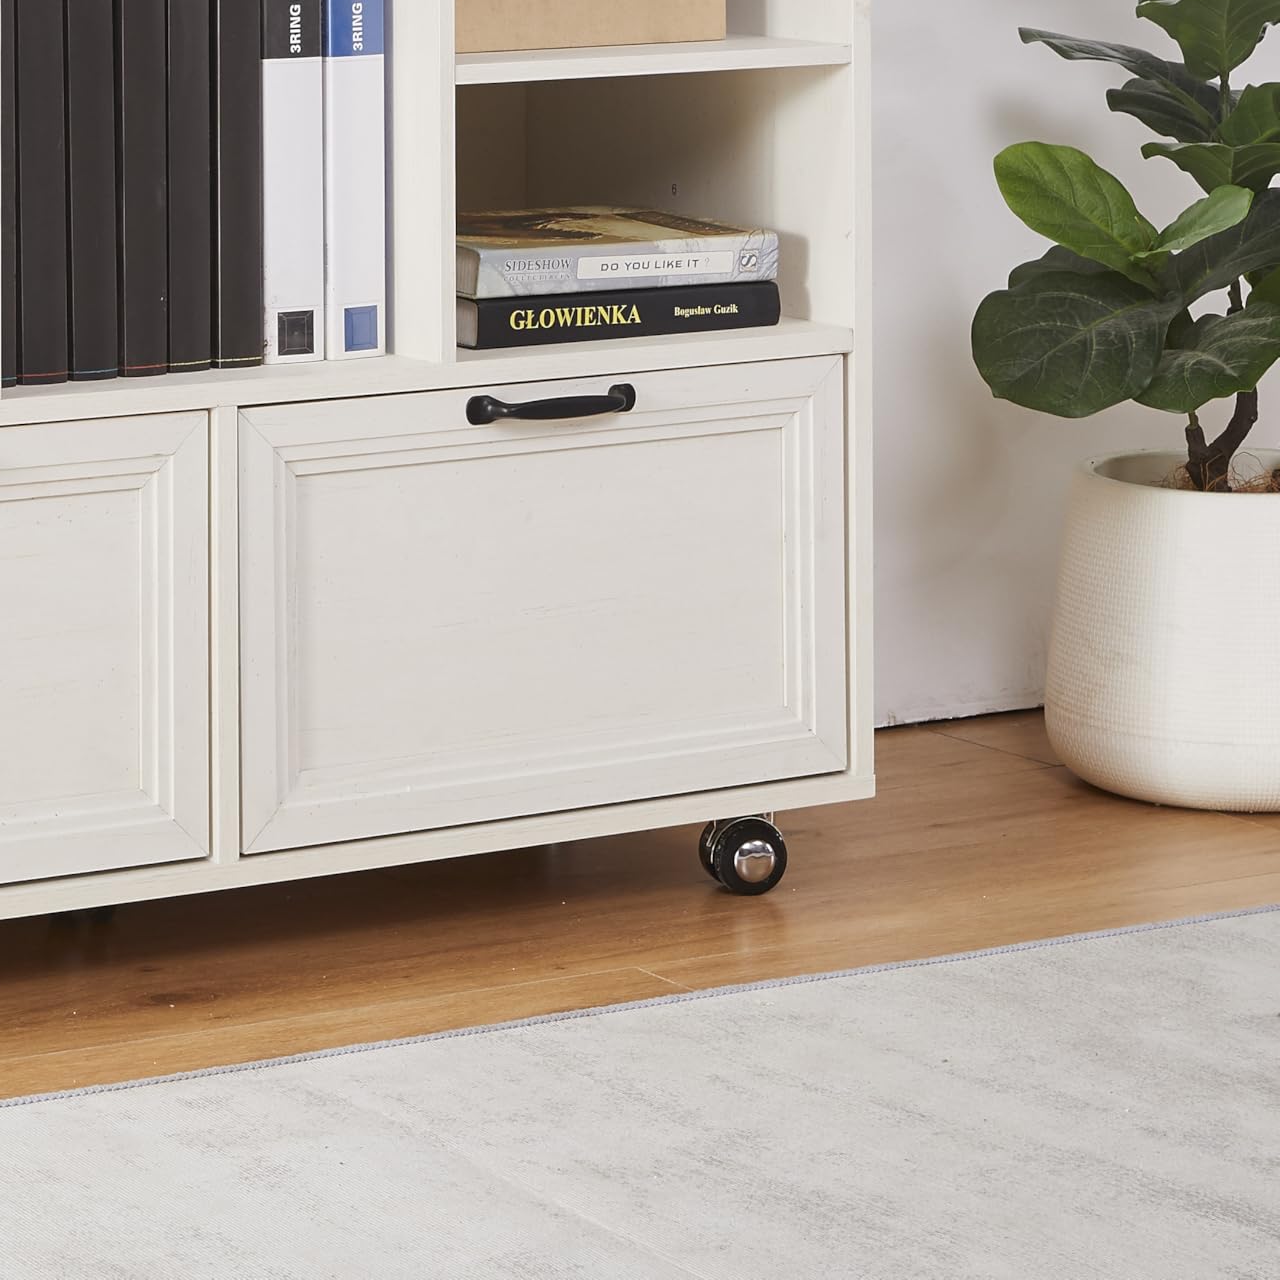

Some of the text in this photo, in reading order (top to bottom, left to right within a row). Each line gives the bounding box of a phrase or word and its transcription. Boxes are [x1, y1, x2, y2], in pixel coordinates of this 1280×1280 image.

[290, 4, 301, 53] 3RING
[352, 3, 363, 51] 3RING
[505, 258, 571, 272] SIDESHOW
[601, 263, 619, 271] DO
[624, 261, 650, 270] YOU
[655, 260, 681, 269] LIKE
[687, 260, 699, 268] IT
[510, 304, 641, 330] GŁOWIENKA
[714, 304, 738, 314] Guzik
